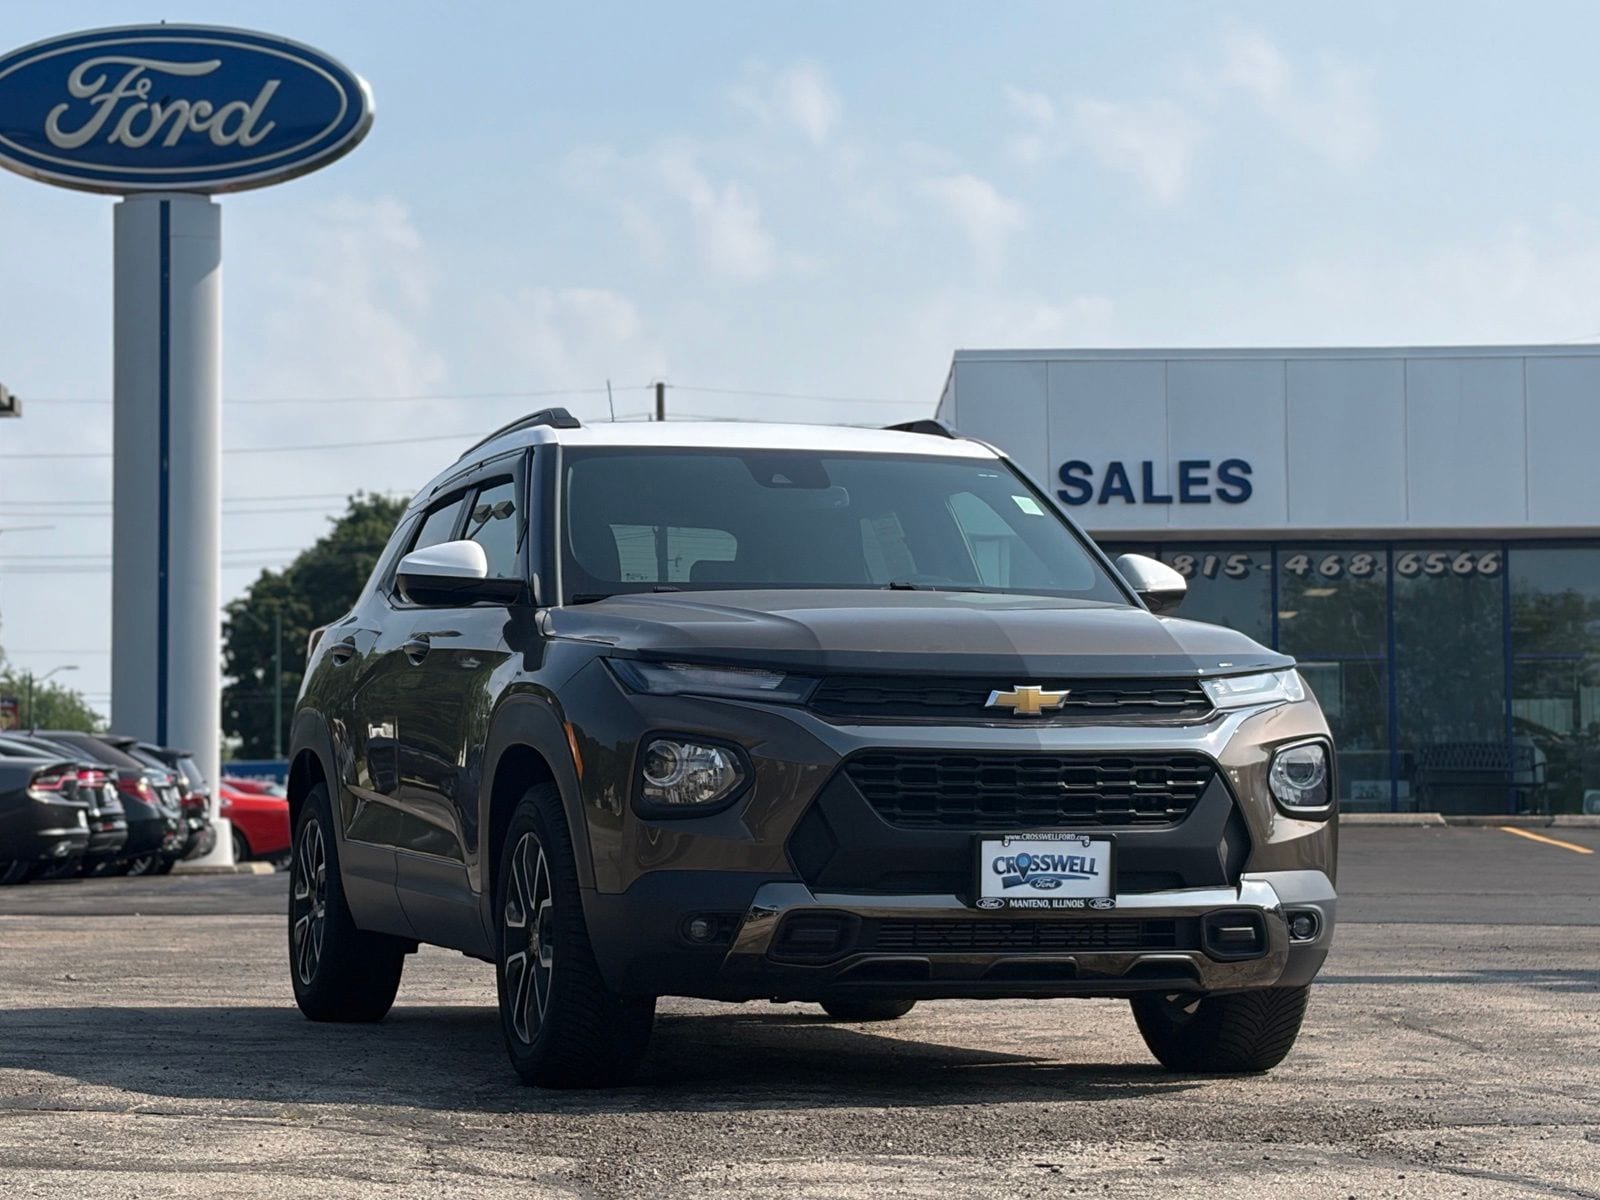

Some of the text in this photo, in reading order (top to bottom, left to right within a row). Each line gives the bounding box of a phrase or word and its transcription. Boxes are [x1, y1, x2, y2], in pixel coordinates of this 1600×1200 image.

[45, 56, 281, 148] Ford
[1056, 458, 1253, 505] SALES
[992, 853, 1099, 881] CROSSWELL
[1009, 899, 1085, 909] MANTENO, ILLINOIS
